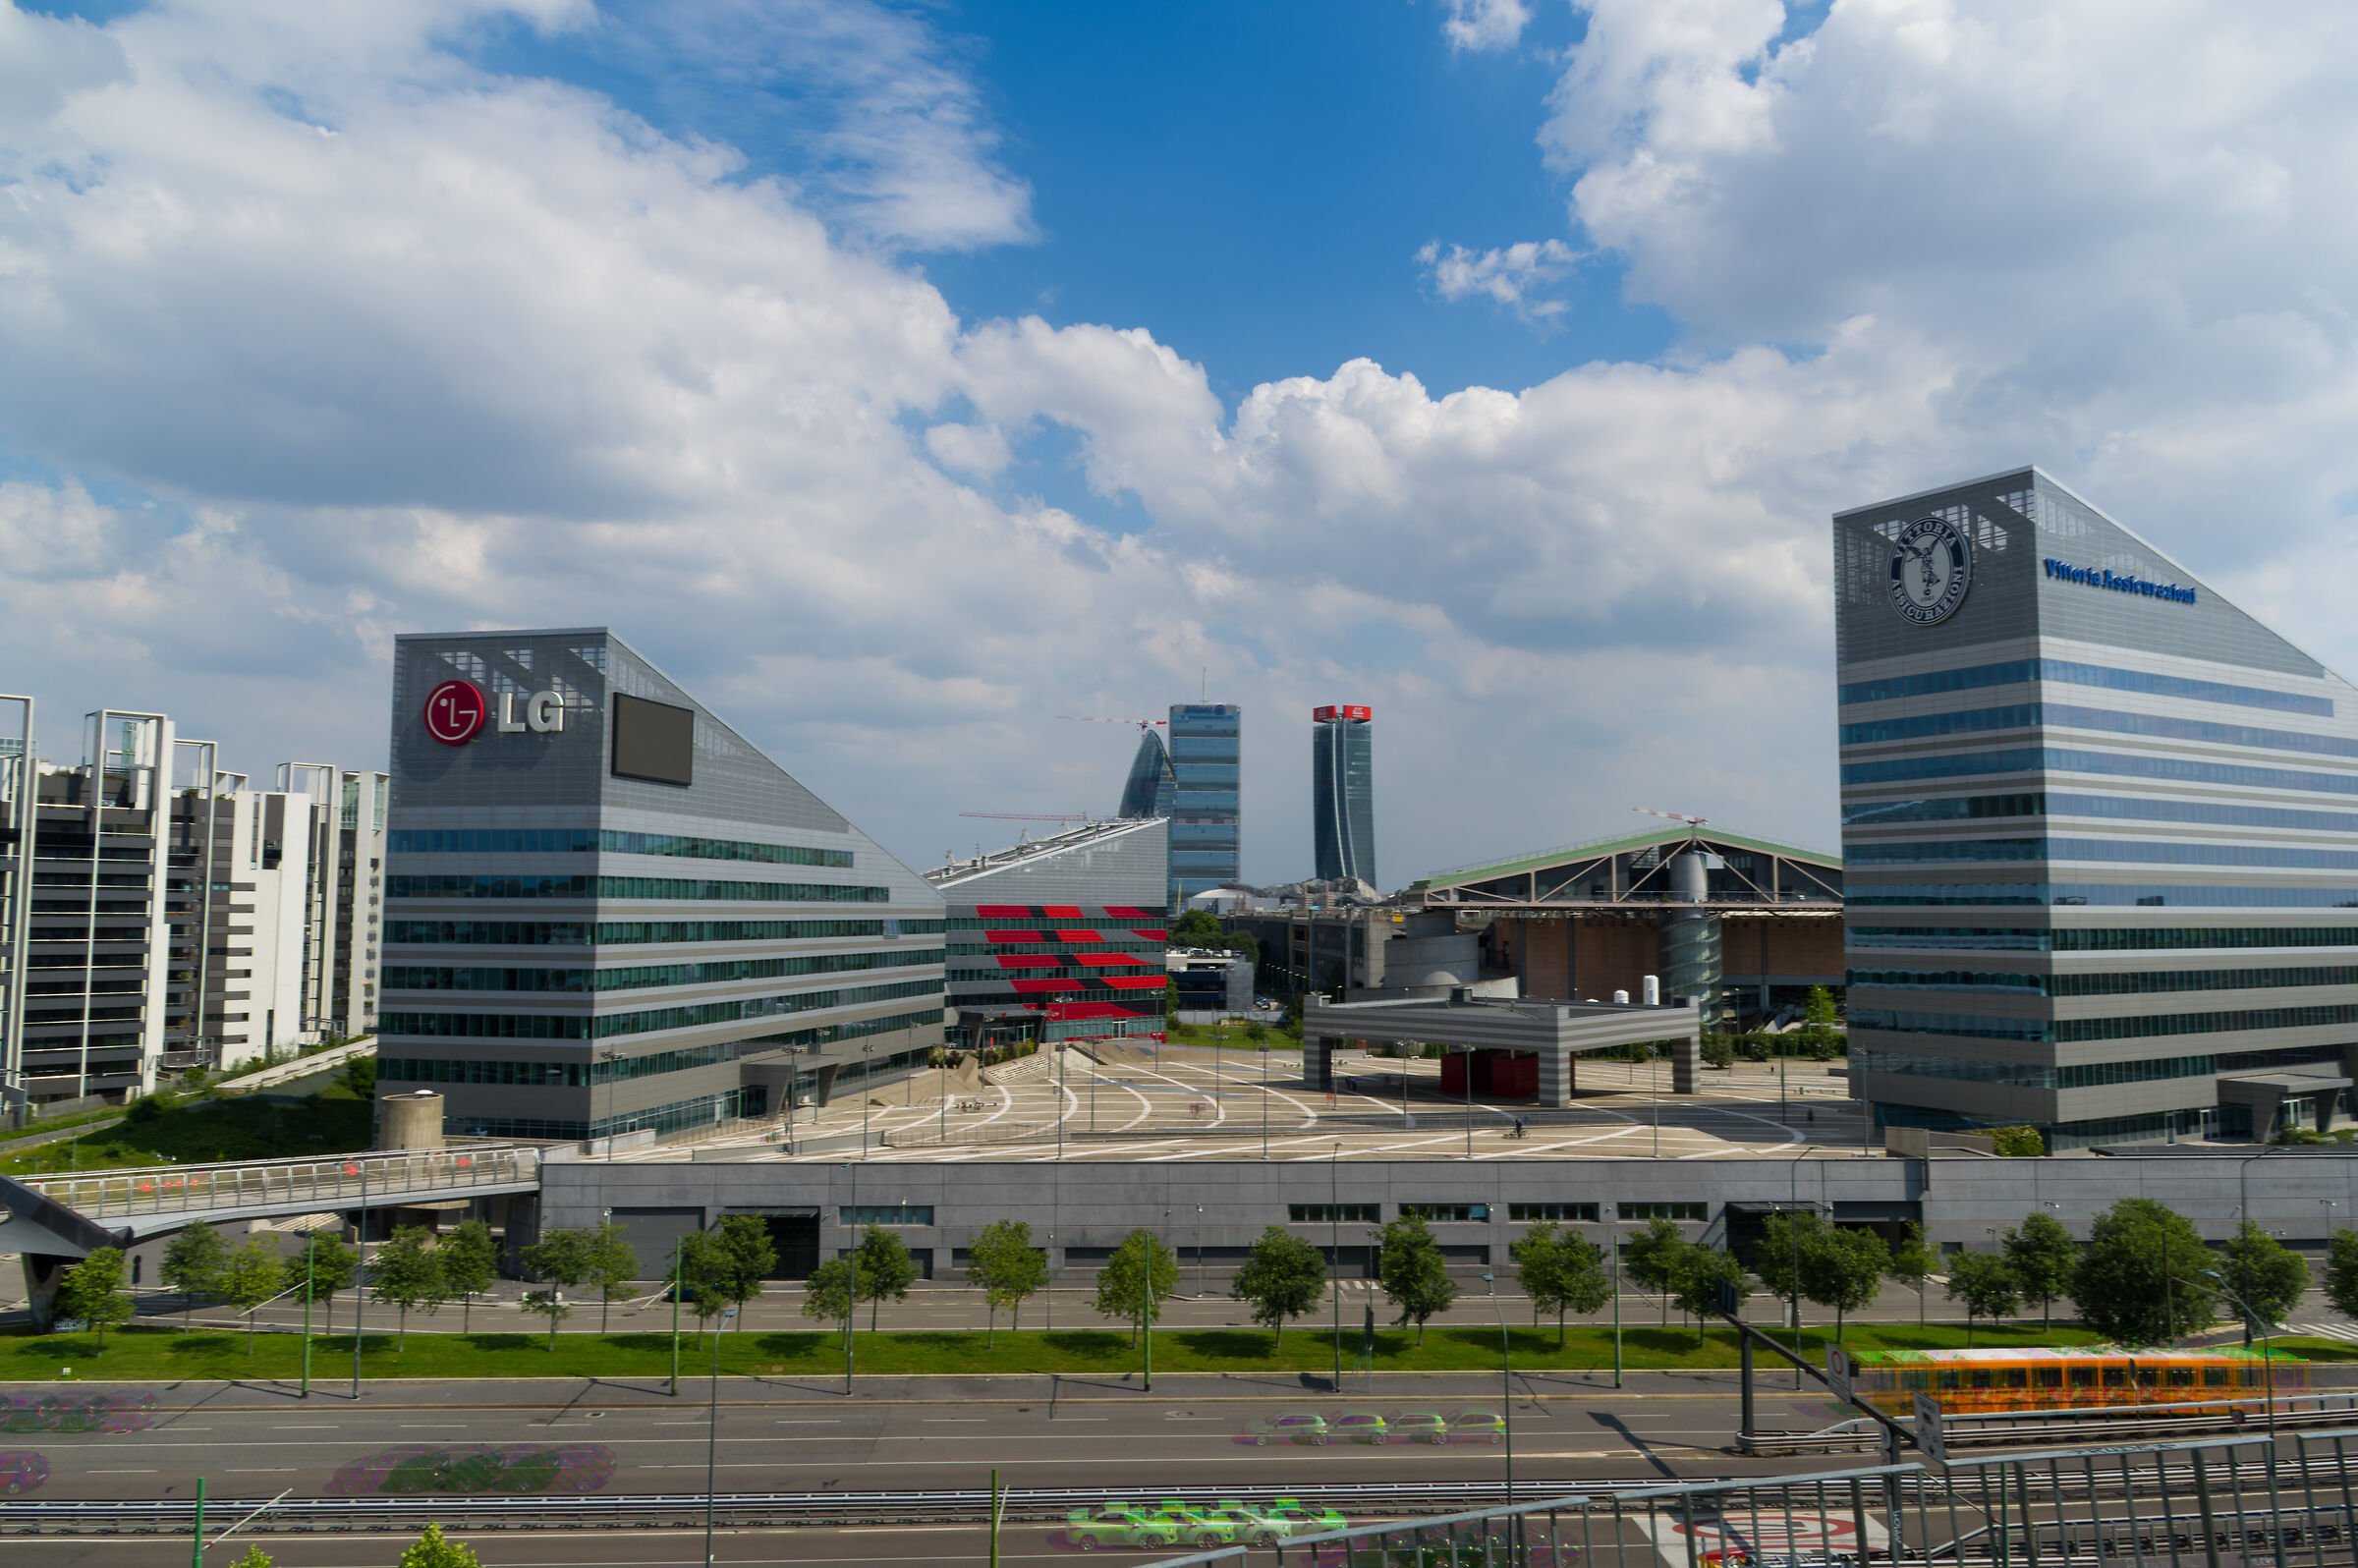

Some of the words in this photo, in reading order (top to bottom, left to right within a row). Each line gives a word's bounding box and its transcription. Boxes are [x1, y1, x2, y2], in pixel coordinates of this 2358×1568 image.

[1894, 521, 1957, 559] VITTORIA
[1891, 566, 1964, 620] ASSICURAZIONI
[2044, 557, 2102, 587] Vittoria
[2103, 569, 2197, 605] Assicurazioni
[497, 690, 565, 733] LG
